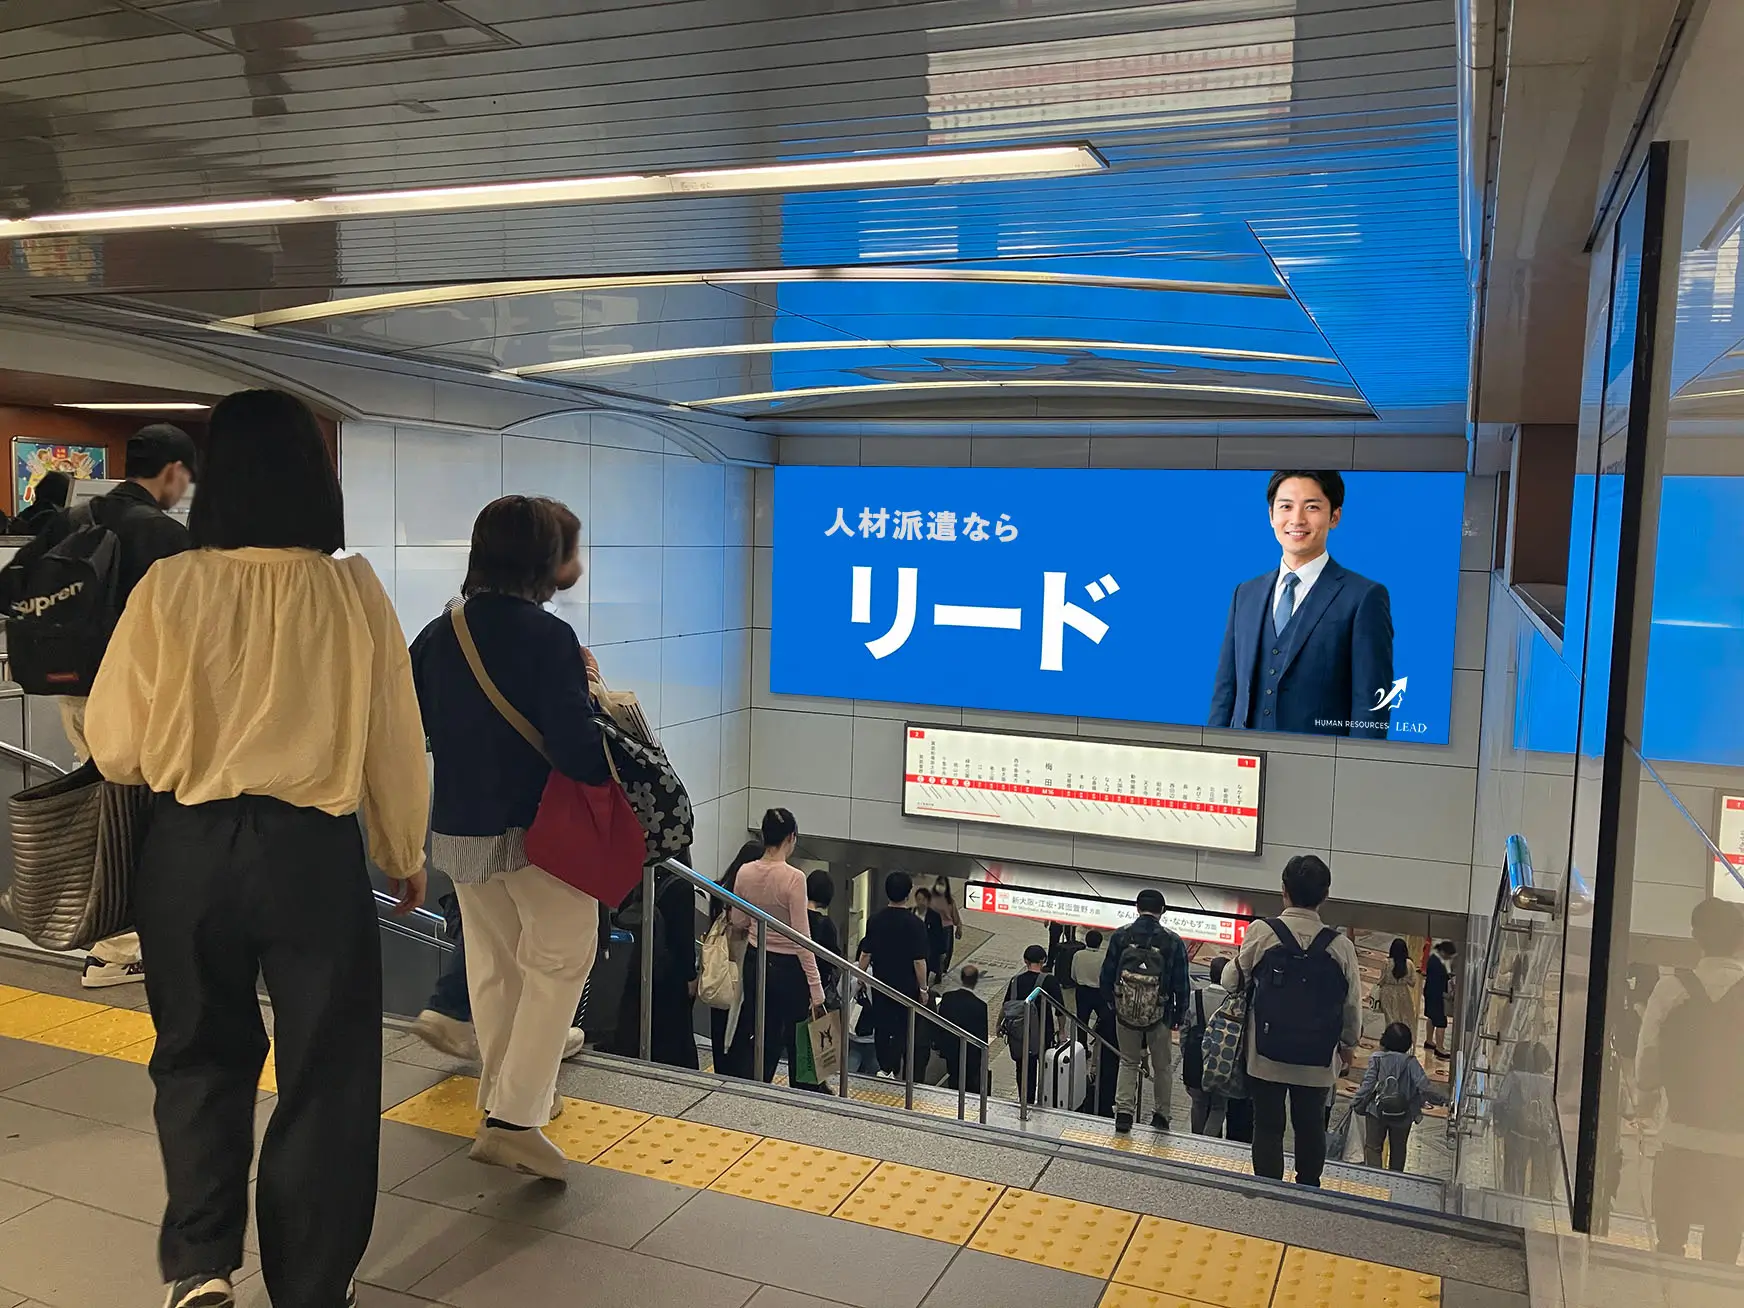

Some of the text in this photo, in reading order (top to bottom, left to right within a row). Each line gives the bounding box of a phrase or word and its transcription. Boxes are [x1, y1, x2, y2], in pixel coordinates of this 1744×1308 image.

[824, 507, 1019, 542] 人材派遣なら
[851, 565, 1121, 672] リード
[1314, 719, 1428, 734] HUMAN RESOURCES LEAD
[1045, 762, 1053, 786] 梅田
[984, 893, 993, 905] 2
